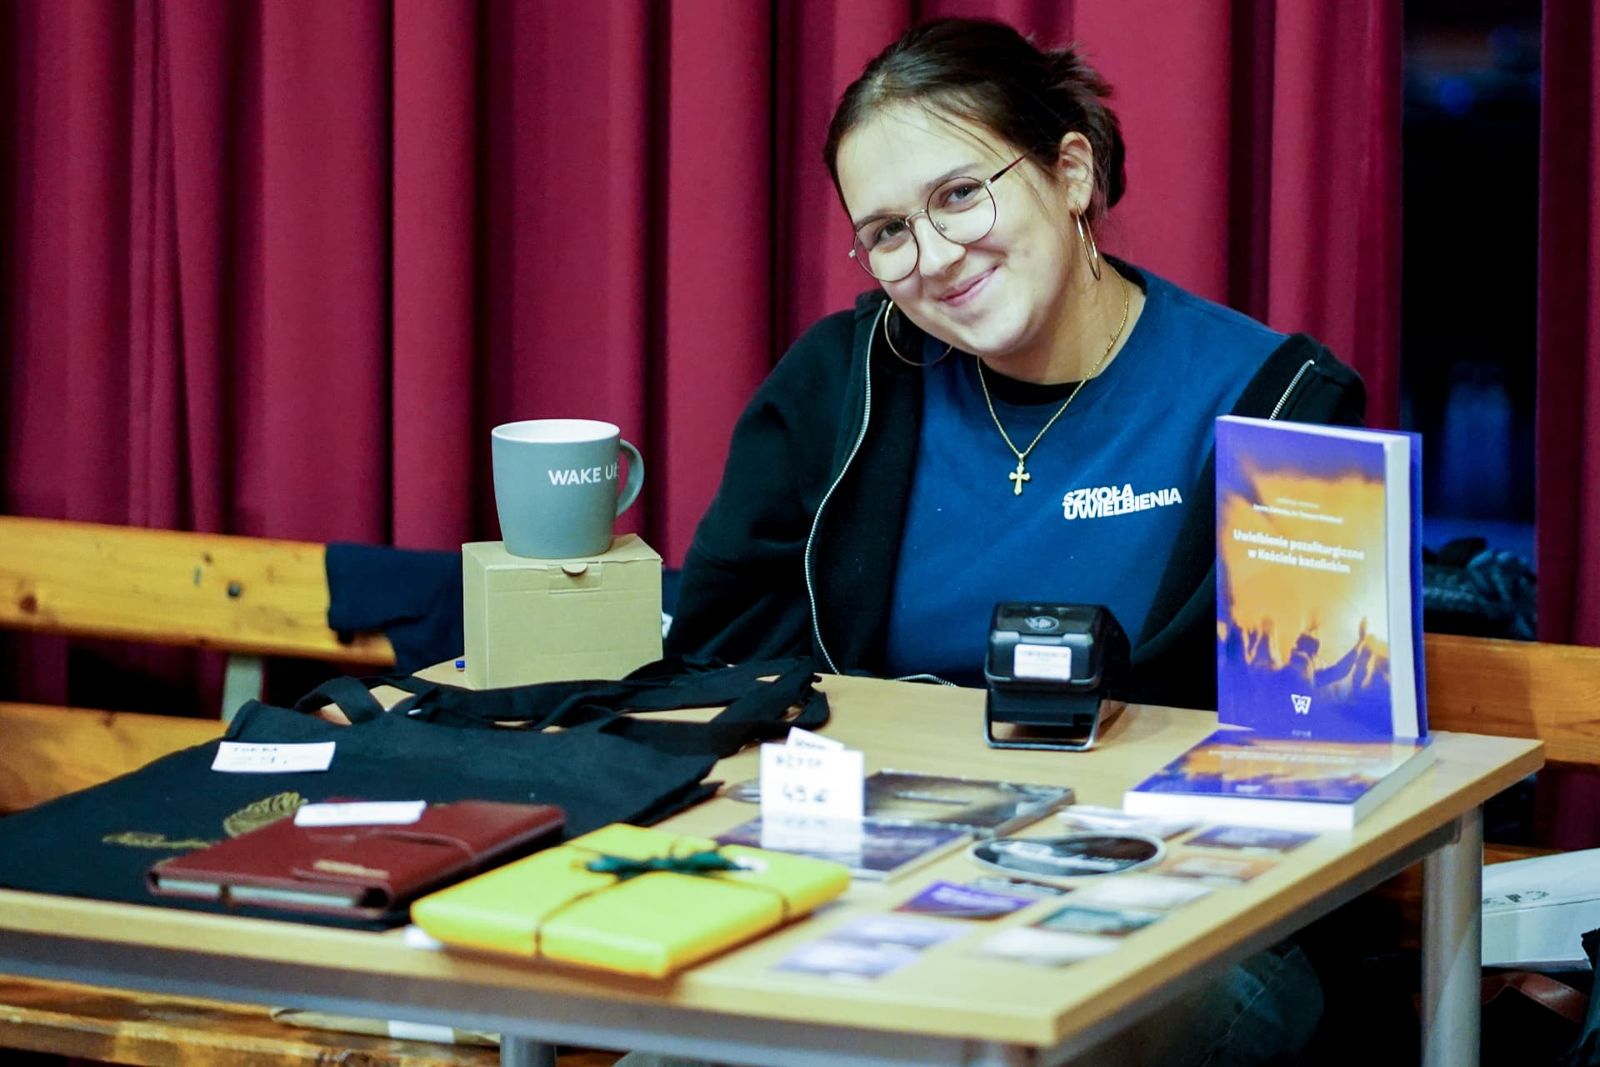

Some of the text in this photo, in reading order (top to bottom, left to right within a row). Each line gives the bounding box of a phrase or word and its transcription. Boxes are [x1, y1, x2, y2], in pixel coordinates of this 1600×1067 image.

[547, 466, 602, 486] WAKE
[1062, 483, 1135, 507] SZKOŁA
[1063, 487, 1183, 520] UWIELBIENIA
